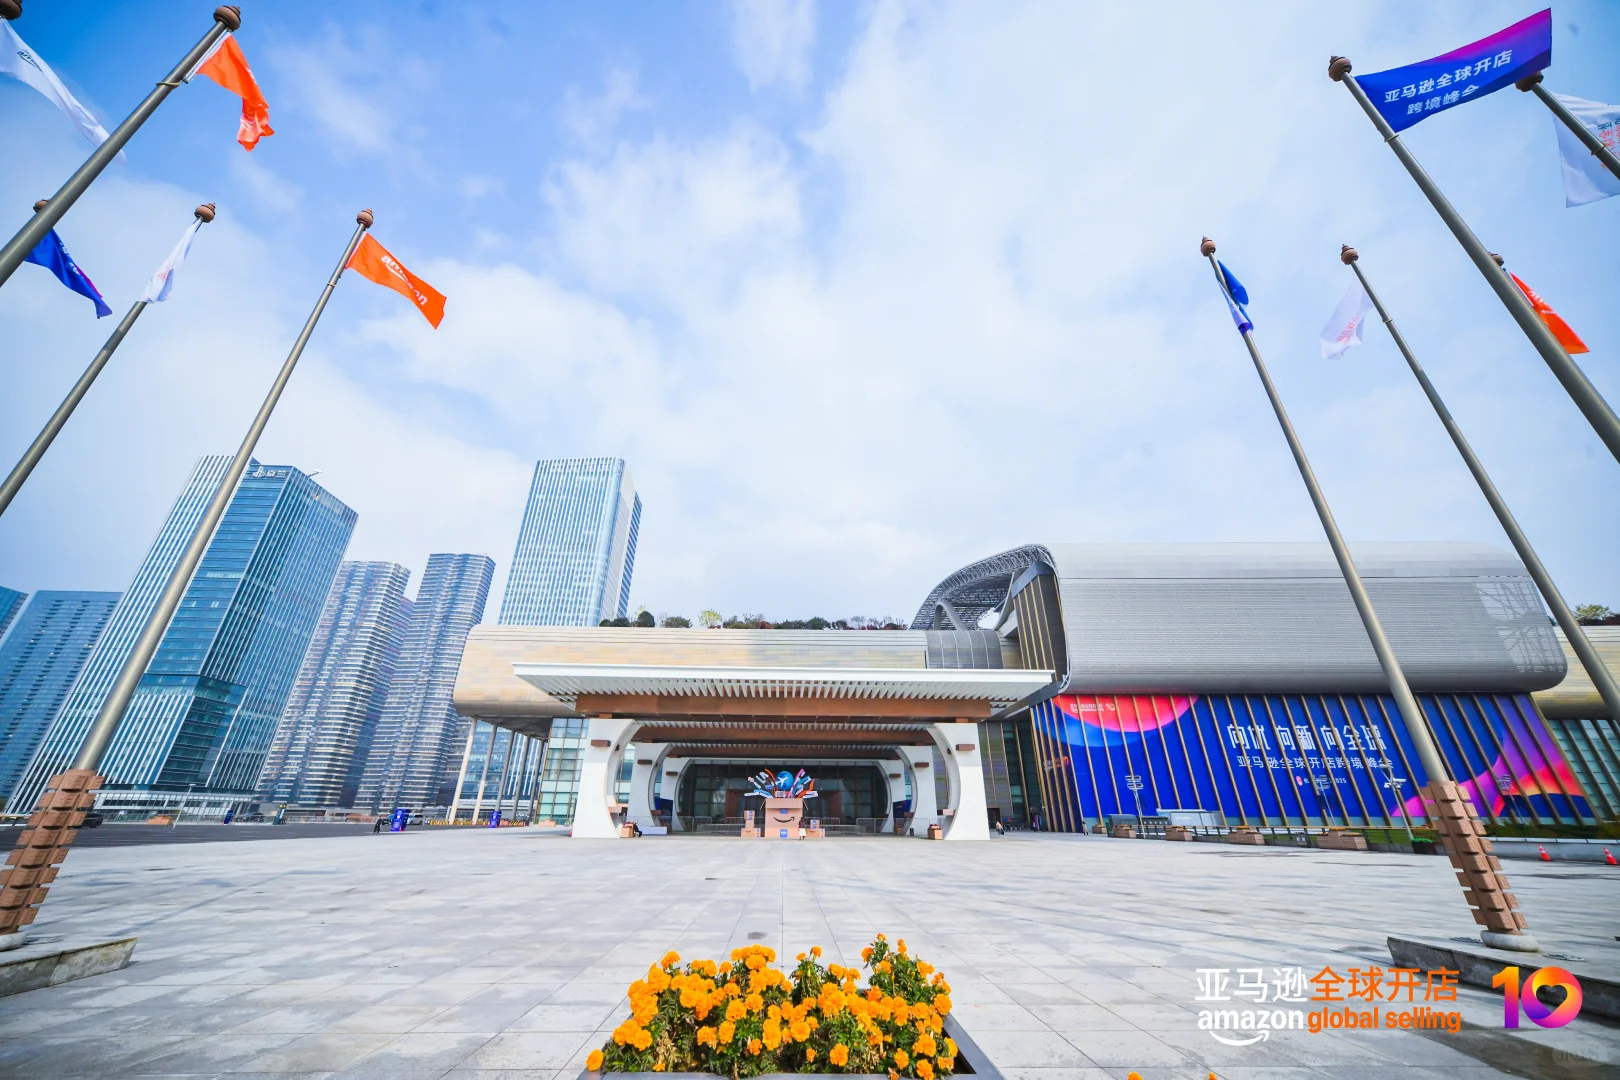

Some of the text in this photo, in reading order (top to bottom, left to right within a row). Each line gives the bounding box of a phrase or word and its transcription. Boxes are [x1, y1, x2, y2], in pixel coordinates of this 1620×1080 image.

[1384, 49, 1513, 103] 亚马逊全球开店
[1226, 723, 1388, 751] 向优 向新 向全球
